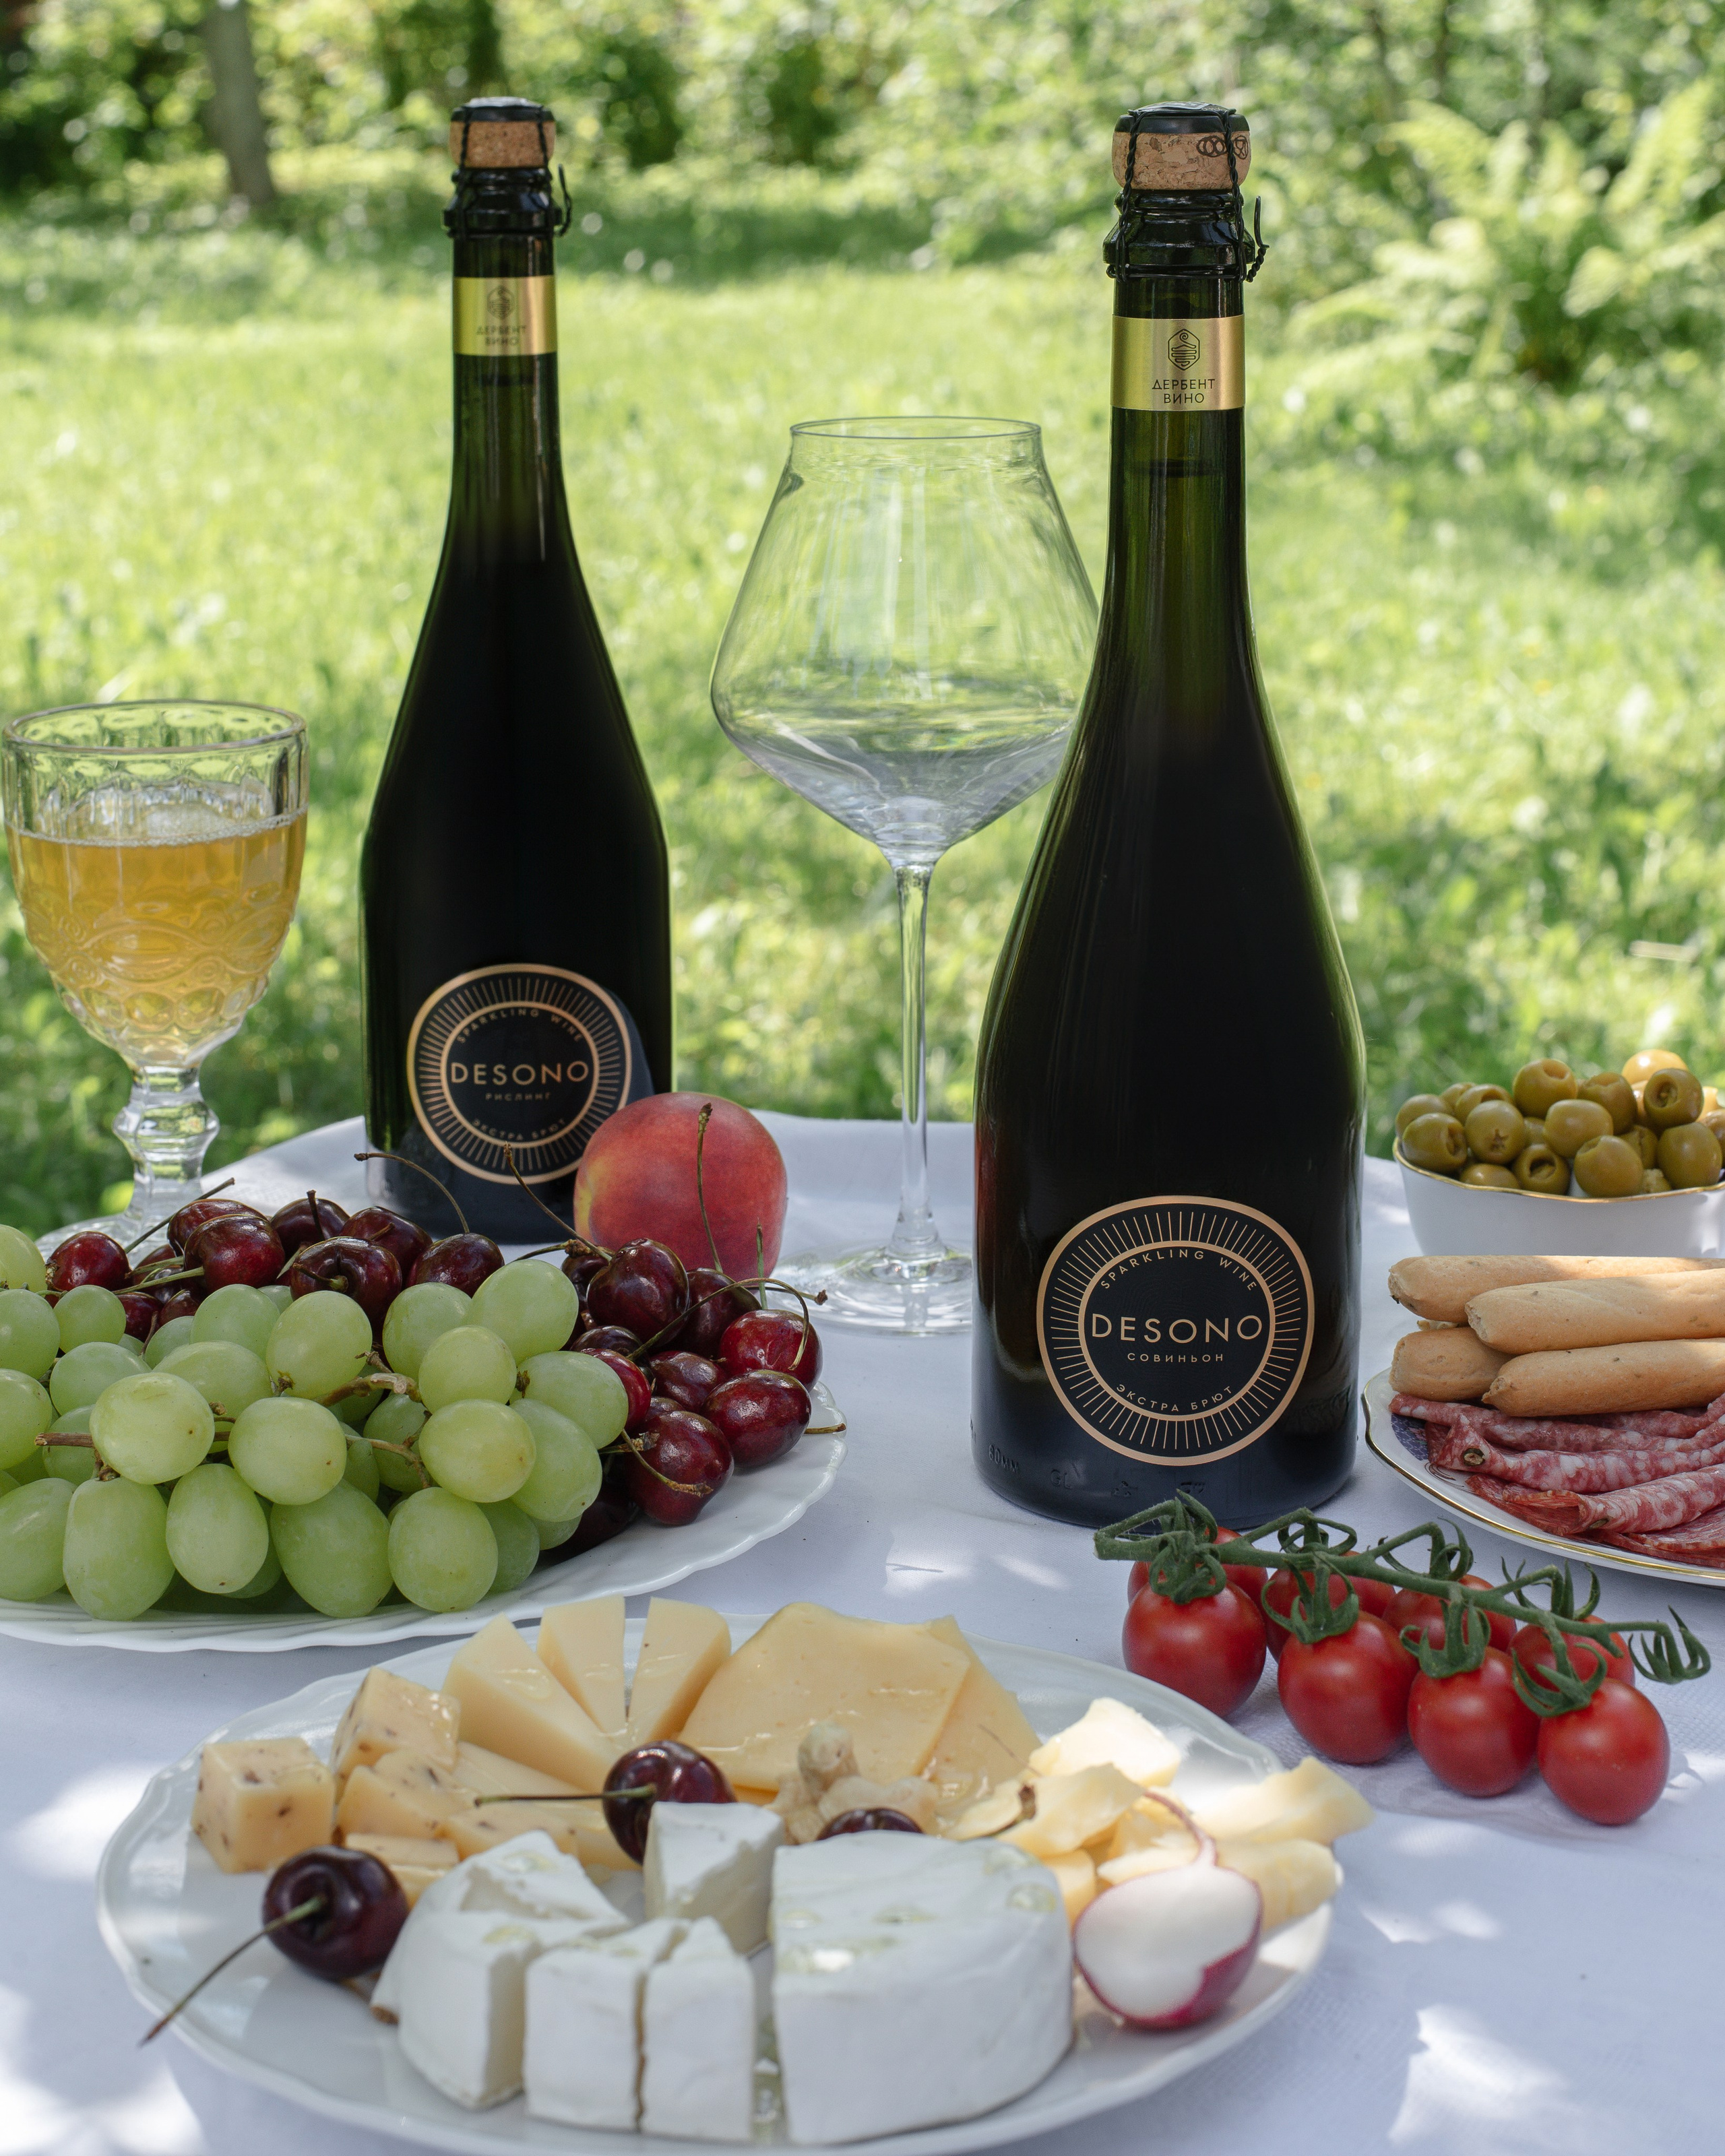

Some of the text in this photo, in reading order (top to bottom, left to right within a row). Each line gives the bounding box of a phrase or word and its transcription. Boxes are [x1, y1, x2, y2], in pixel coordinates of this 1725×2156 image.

[1152, 379, 1216, 390] ДЕРБЕНТ
[1164, 393, 1205, 404] ВИНО
[456, 1008, 584, 1044] SPARKLING WINE
[451, 1060, 589, 1086] DESONO
[485, 1091, 552, 1102] РИСЛИНГ
[472, 1117, 566, 1141] ЭКСТРА БРЮТ
[1101, 1248, 1257, 1291] SPARKLING WINE
[1092, 1312, 1263, 1344] DESONO
[1127, 1352, 1224, 1363] СОВИНЬОН
[1116, 1383, 1234, 1412] ЭКСТРА БРЮТ
